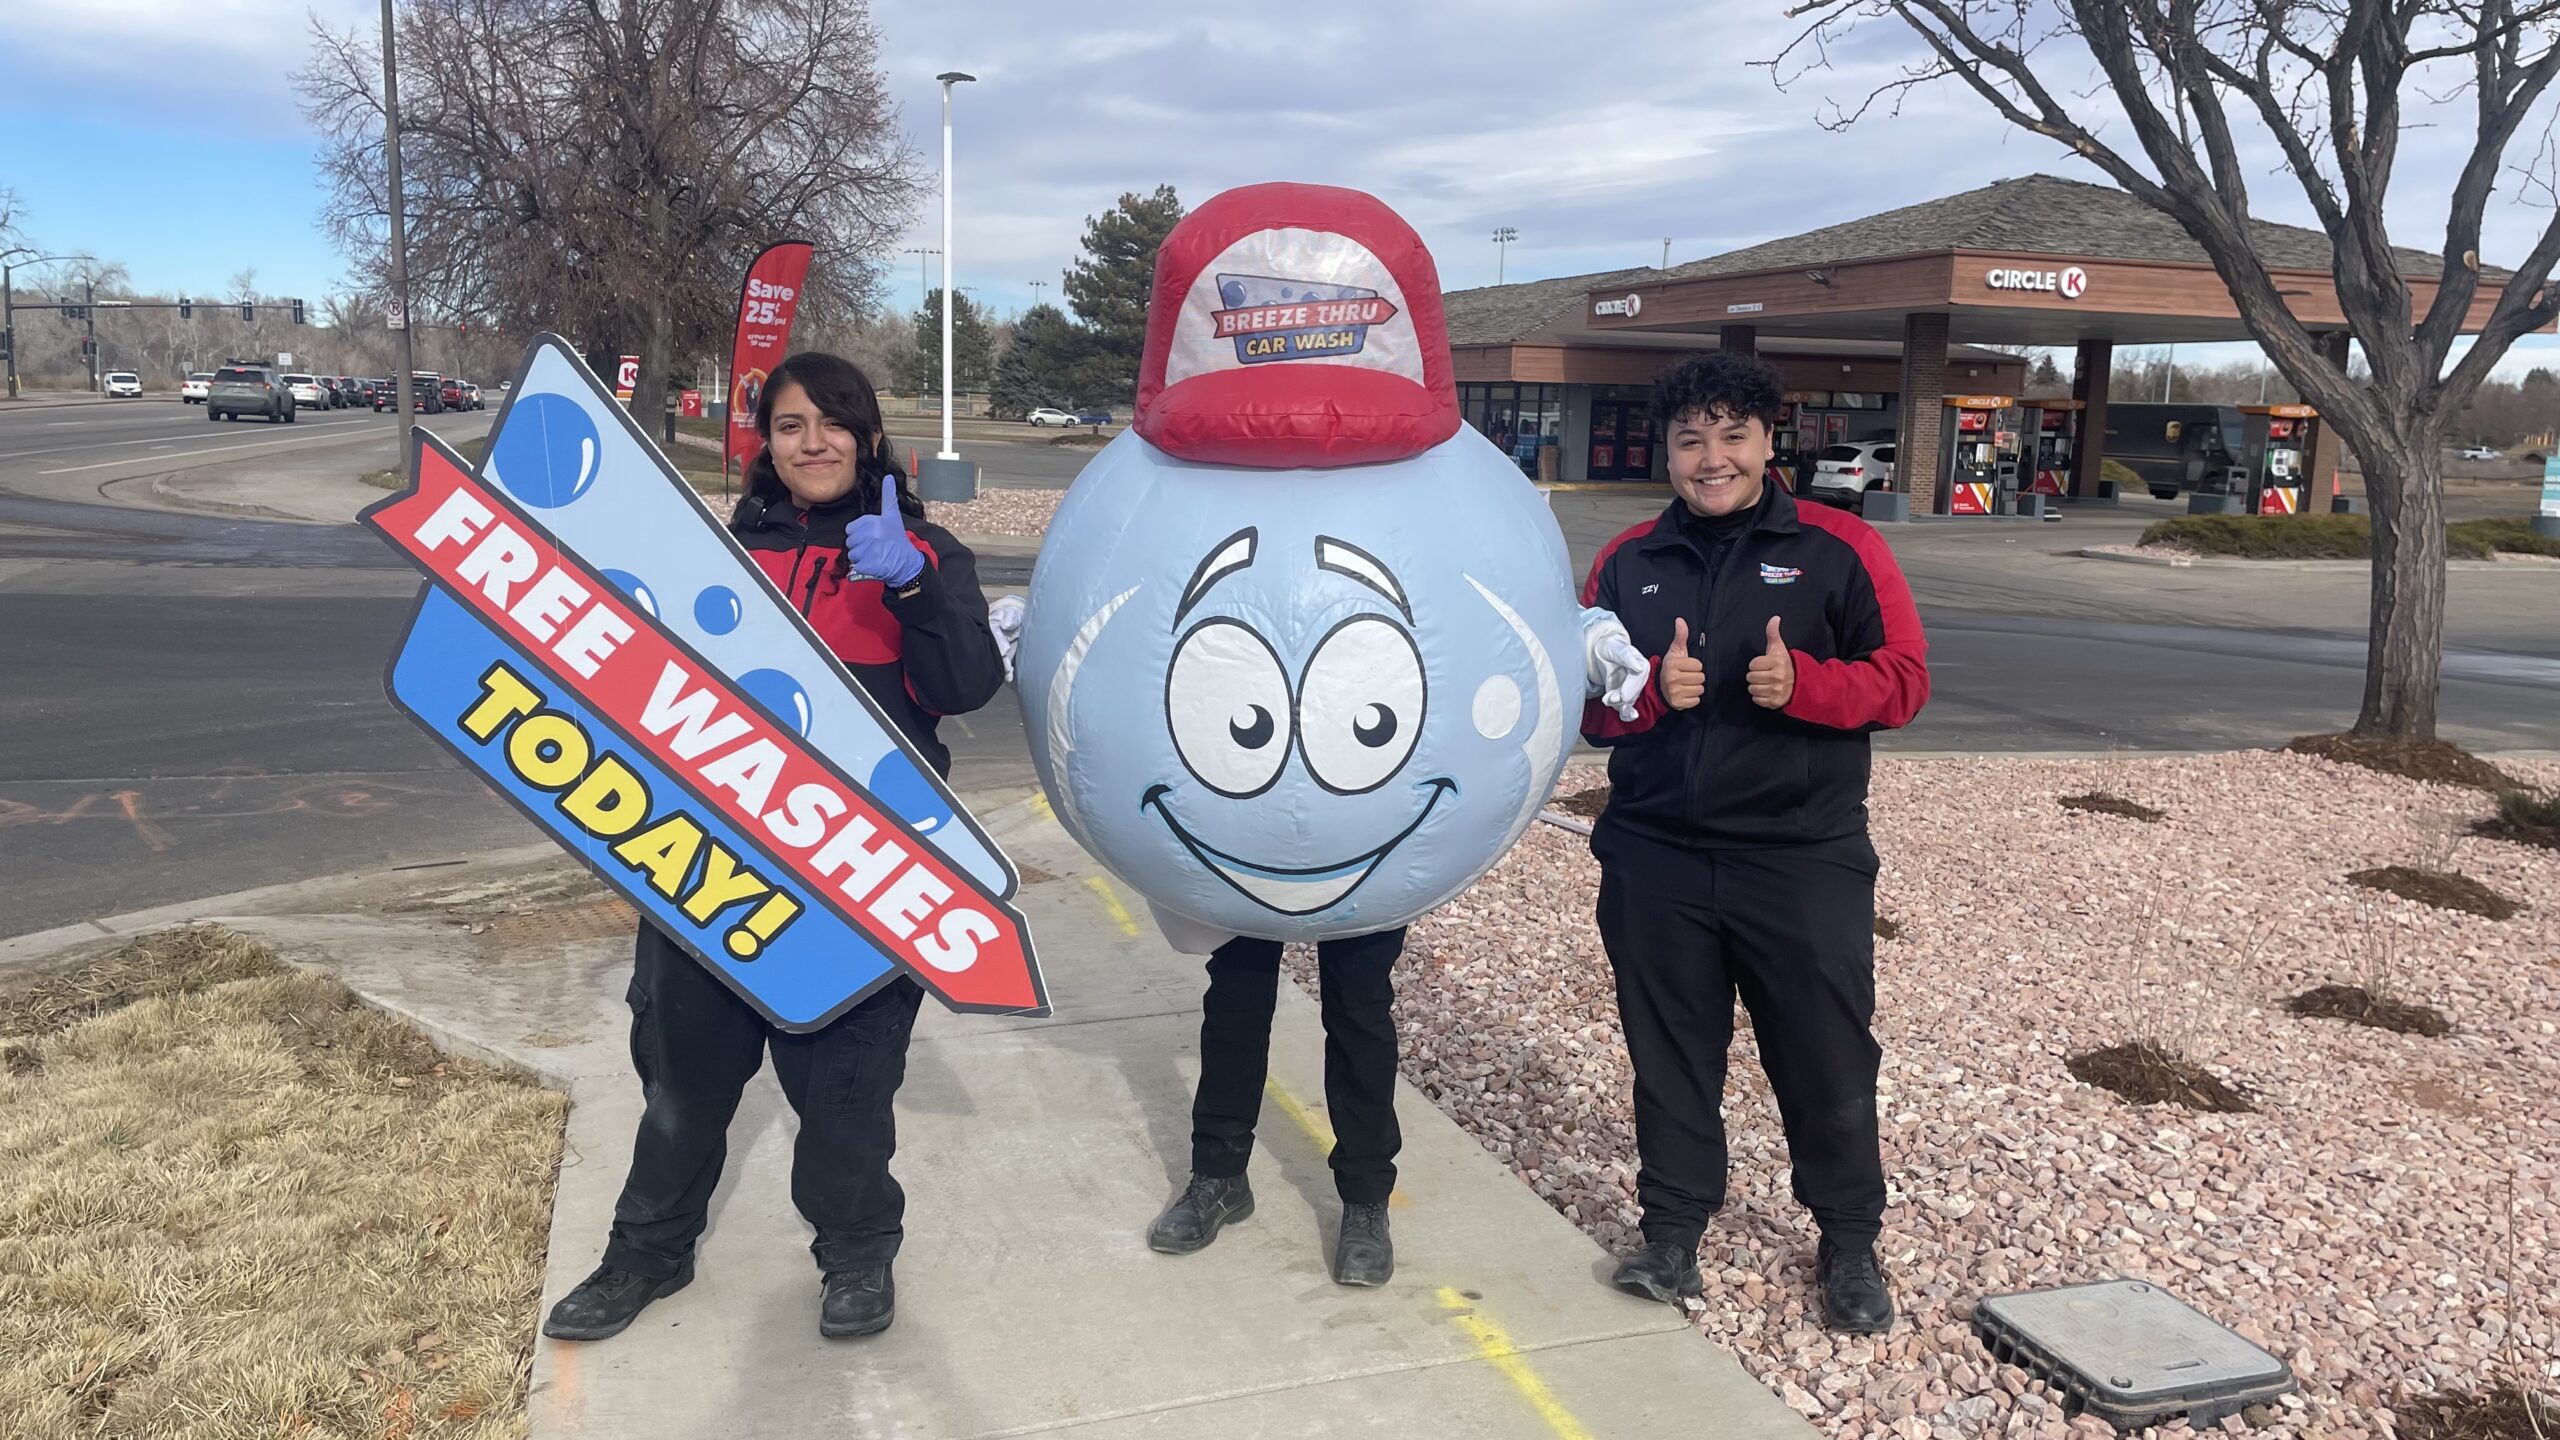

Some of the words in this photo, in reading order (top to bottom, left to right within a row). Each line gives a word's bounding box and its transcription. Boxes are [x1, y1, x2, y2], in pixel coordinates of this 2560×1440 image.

[747, 278, 795, 302] Save
[1986, 268, 2057, 291] CIRCLE
[1222, 307, 1308, 333] BREEZE
[1317, 302, 1380, 325] THRU
[1245, 337, 1287, 356] CAR
[1294, 331, 1355, 352] WASH
[413, 487, 636, 680] FREE
[638, 660, 1000, 973] WASHES
[460, 662, 802, 958] TODAY!
